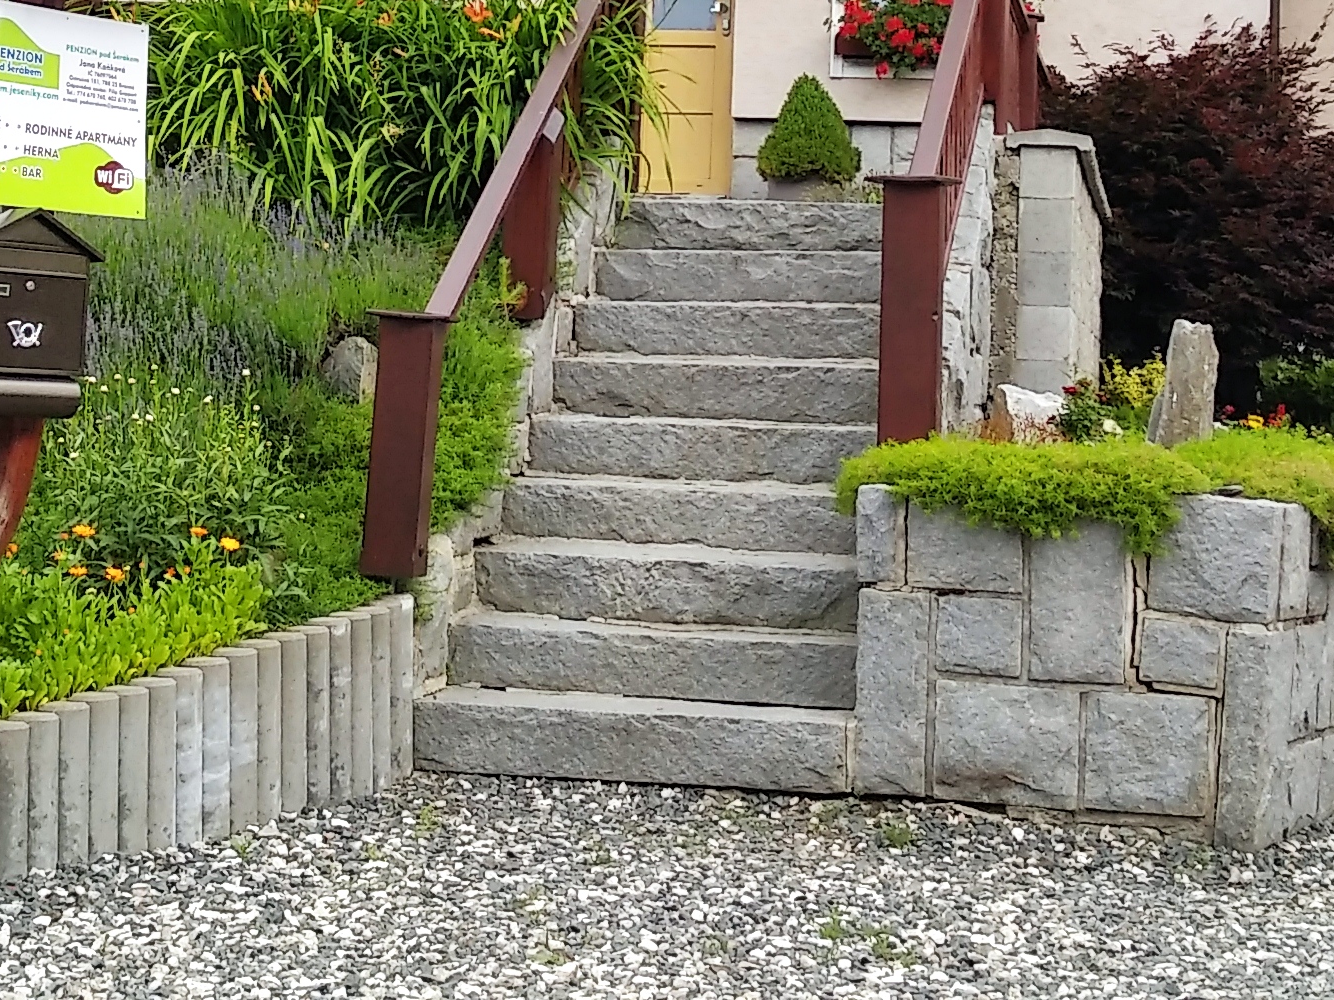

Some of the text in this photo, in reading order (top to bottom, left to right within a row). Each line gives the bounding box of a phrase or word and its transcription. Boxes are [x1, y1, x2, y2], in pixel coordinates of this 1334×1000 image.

[66, 44, 98, 56] PENZION
[99, 51, 111, 59] pod
[25, 122, 138, 147] RODINNÉ APARTMÁNY
[23, 145, 59, 159] HERNA
[22, 166, 42, 178] BAR
